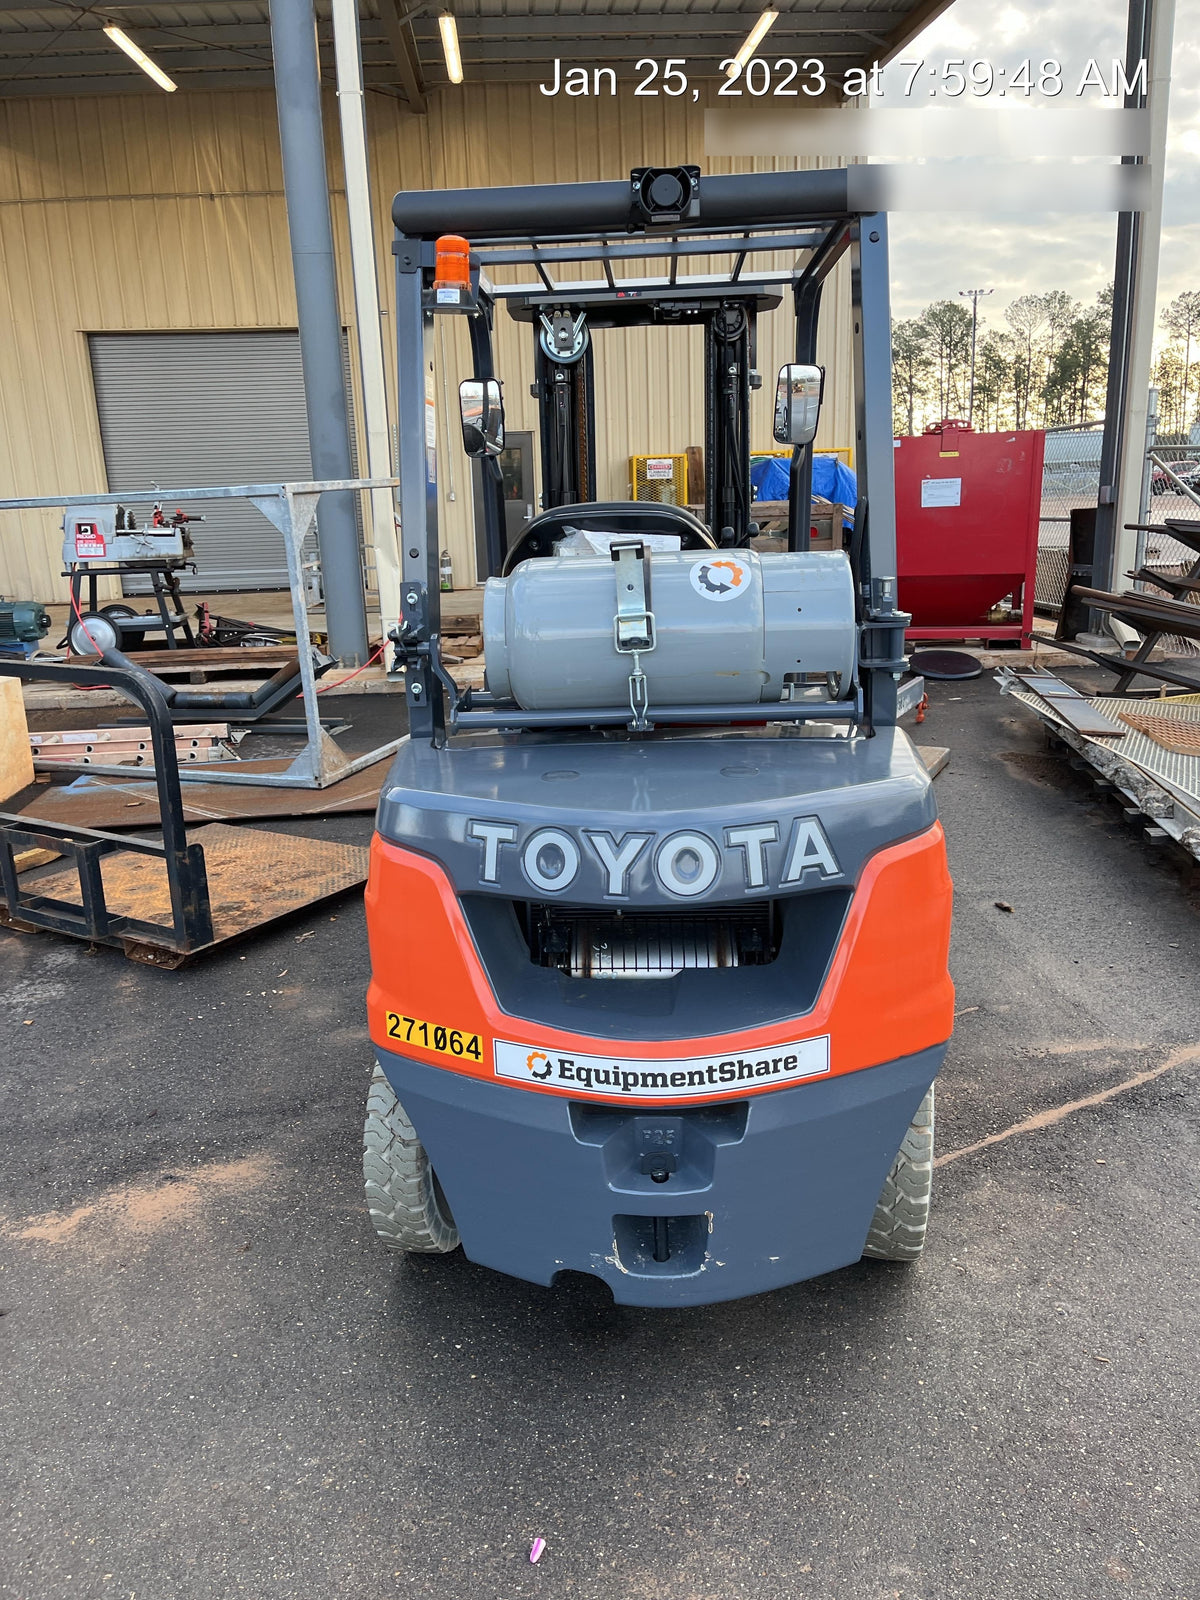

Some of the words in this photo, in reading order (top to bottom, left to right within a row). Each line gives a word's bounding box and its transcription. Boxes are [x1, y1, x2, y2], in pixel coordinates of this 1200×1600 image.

[470, 816, 841, 898] TOYOTA
[387, 1013, 482, 1061] 271064
[558, 1054, 798, 1092] EquipmentShare
